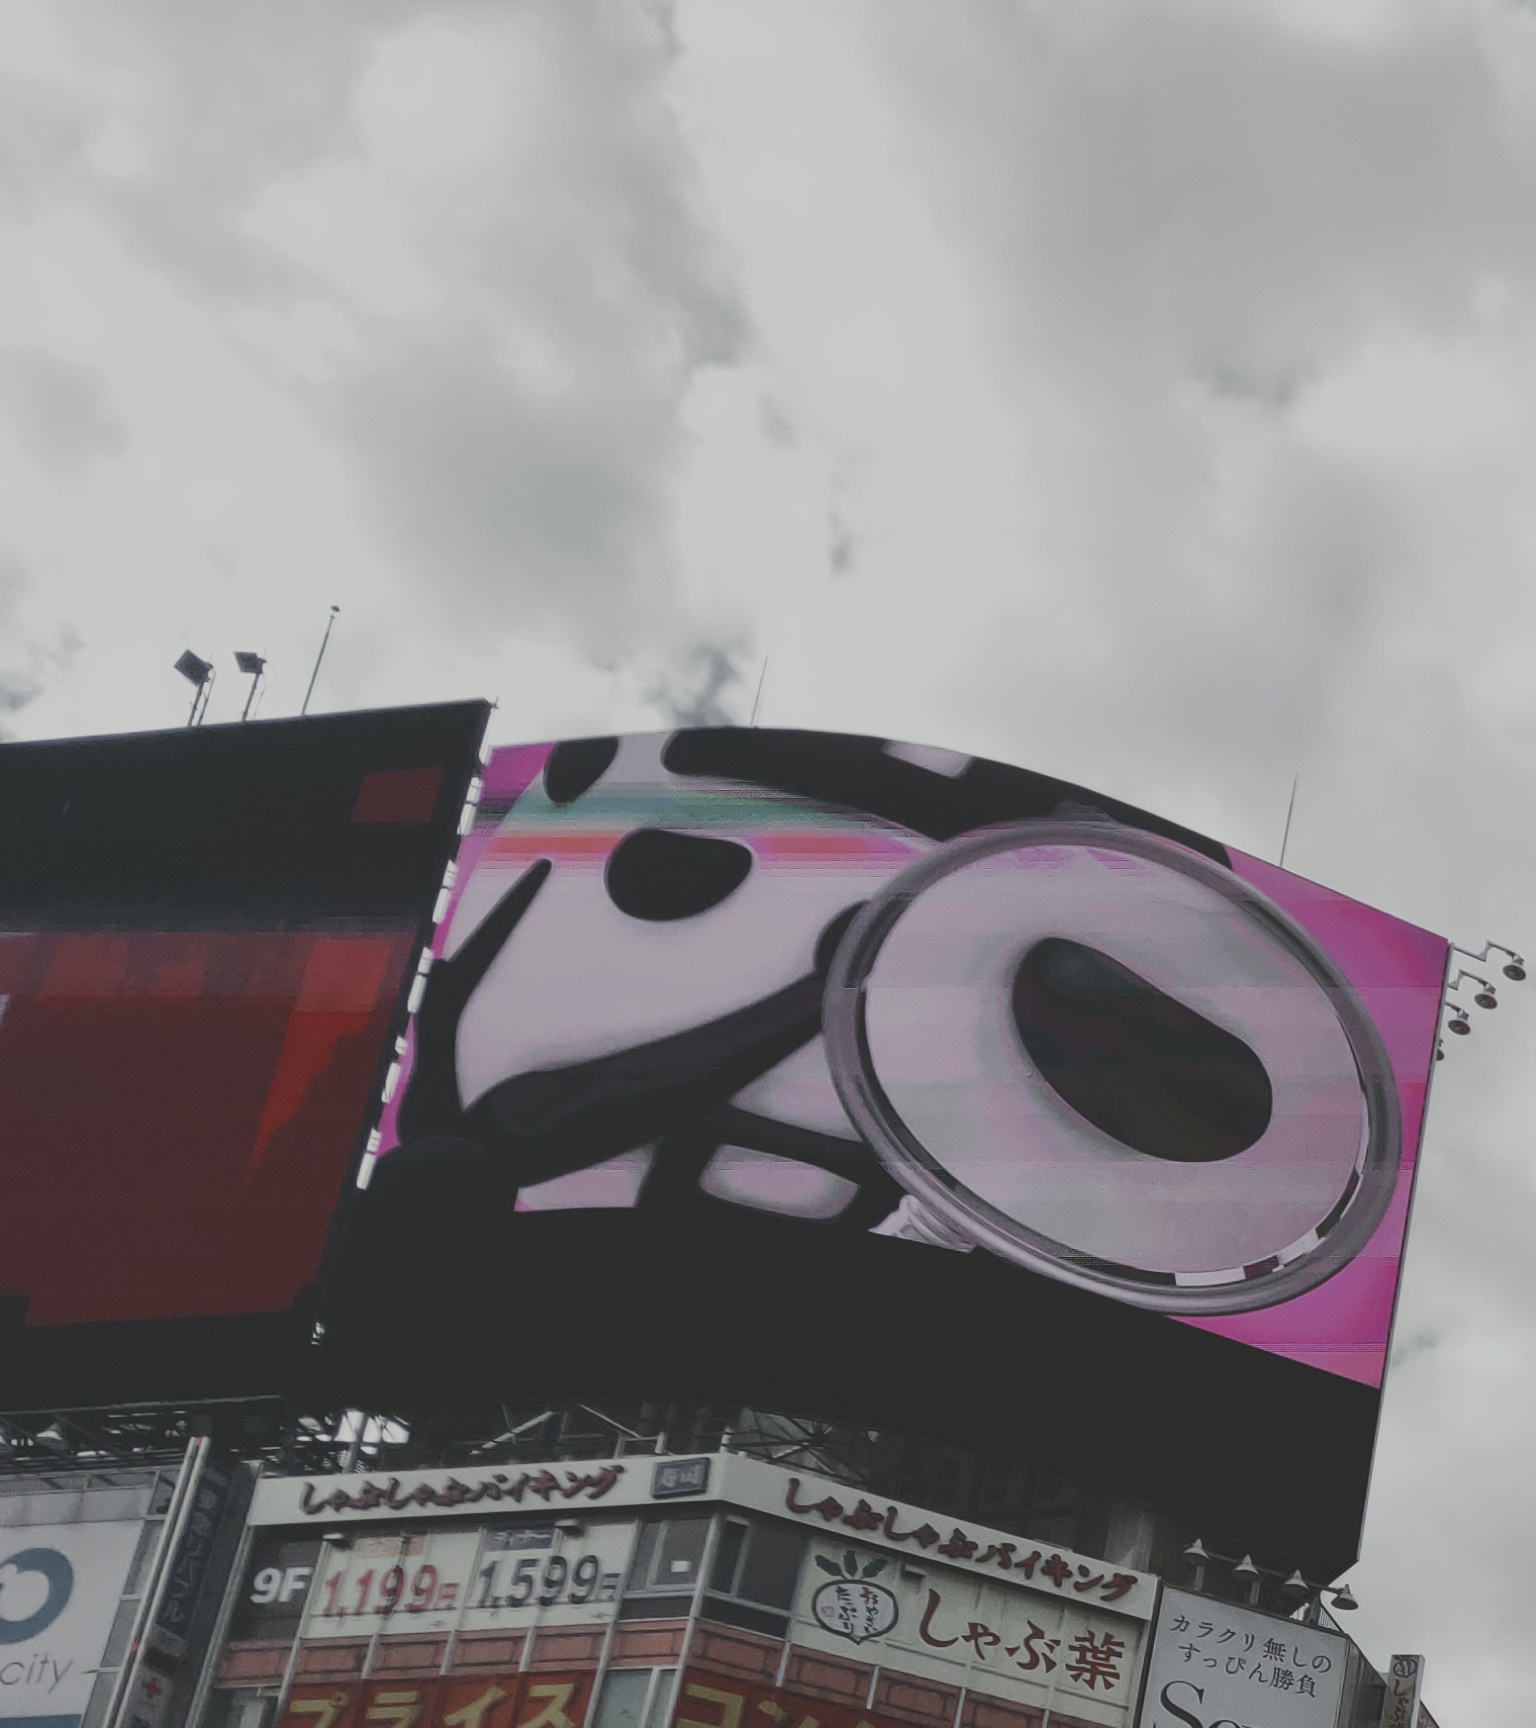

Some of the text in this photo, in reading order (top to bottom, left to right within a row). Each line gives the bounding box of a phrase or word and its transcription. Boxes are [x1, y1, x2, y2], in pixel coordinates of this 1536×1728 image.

[785, 1477, 1139, 1602] しゃぶしゃぶバイキング
[250, 1567, 312, 1604] 9F
[919, 1588, 1126, 1691] しゃぶ葉
[1171, 1614, 1332, 1674] カラクリ無しの
[1179, 1642, 1316, 1698] すっぴん勝負
